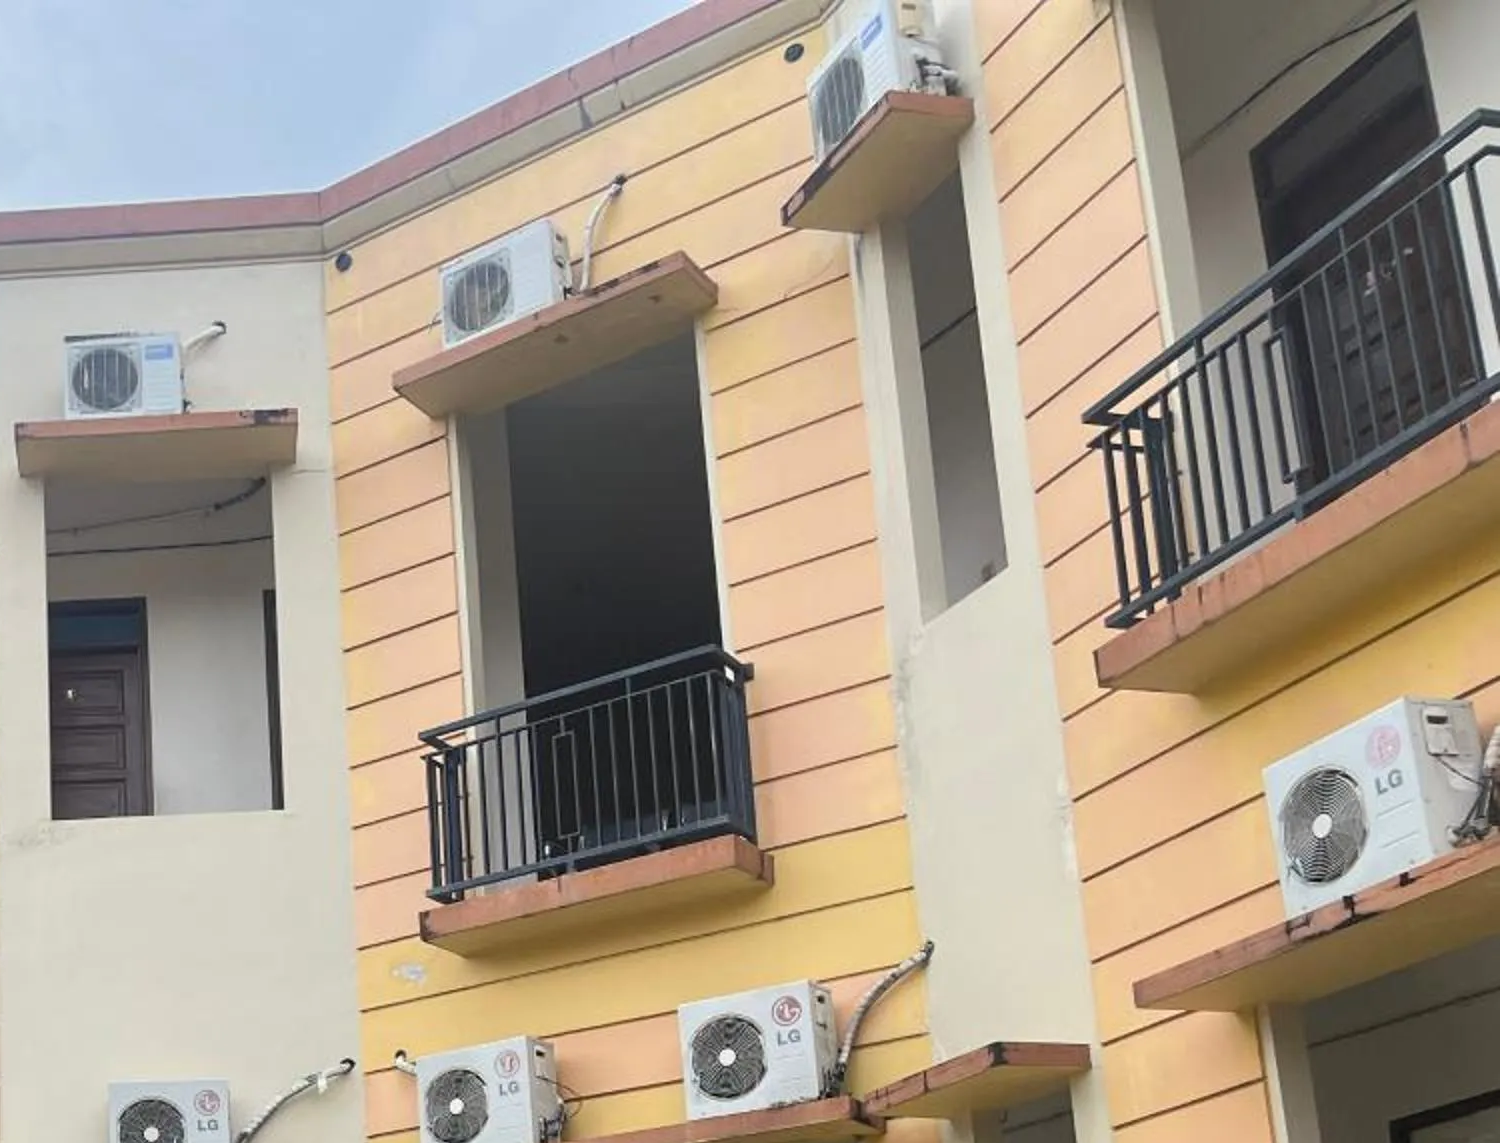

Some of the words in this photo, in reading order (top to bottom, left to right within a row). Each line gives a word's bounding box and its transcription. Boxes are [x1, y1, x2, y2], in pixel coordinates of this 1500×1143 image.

[1374, 769, 1404, 796] LG
[777, 1029, 801, 1047] LG
[499, 1081, 520, 1097] LG
[197, 1119, 219, 1131] LG
